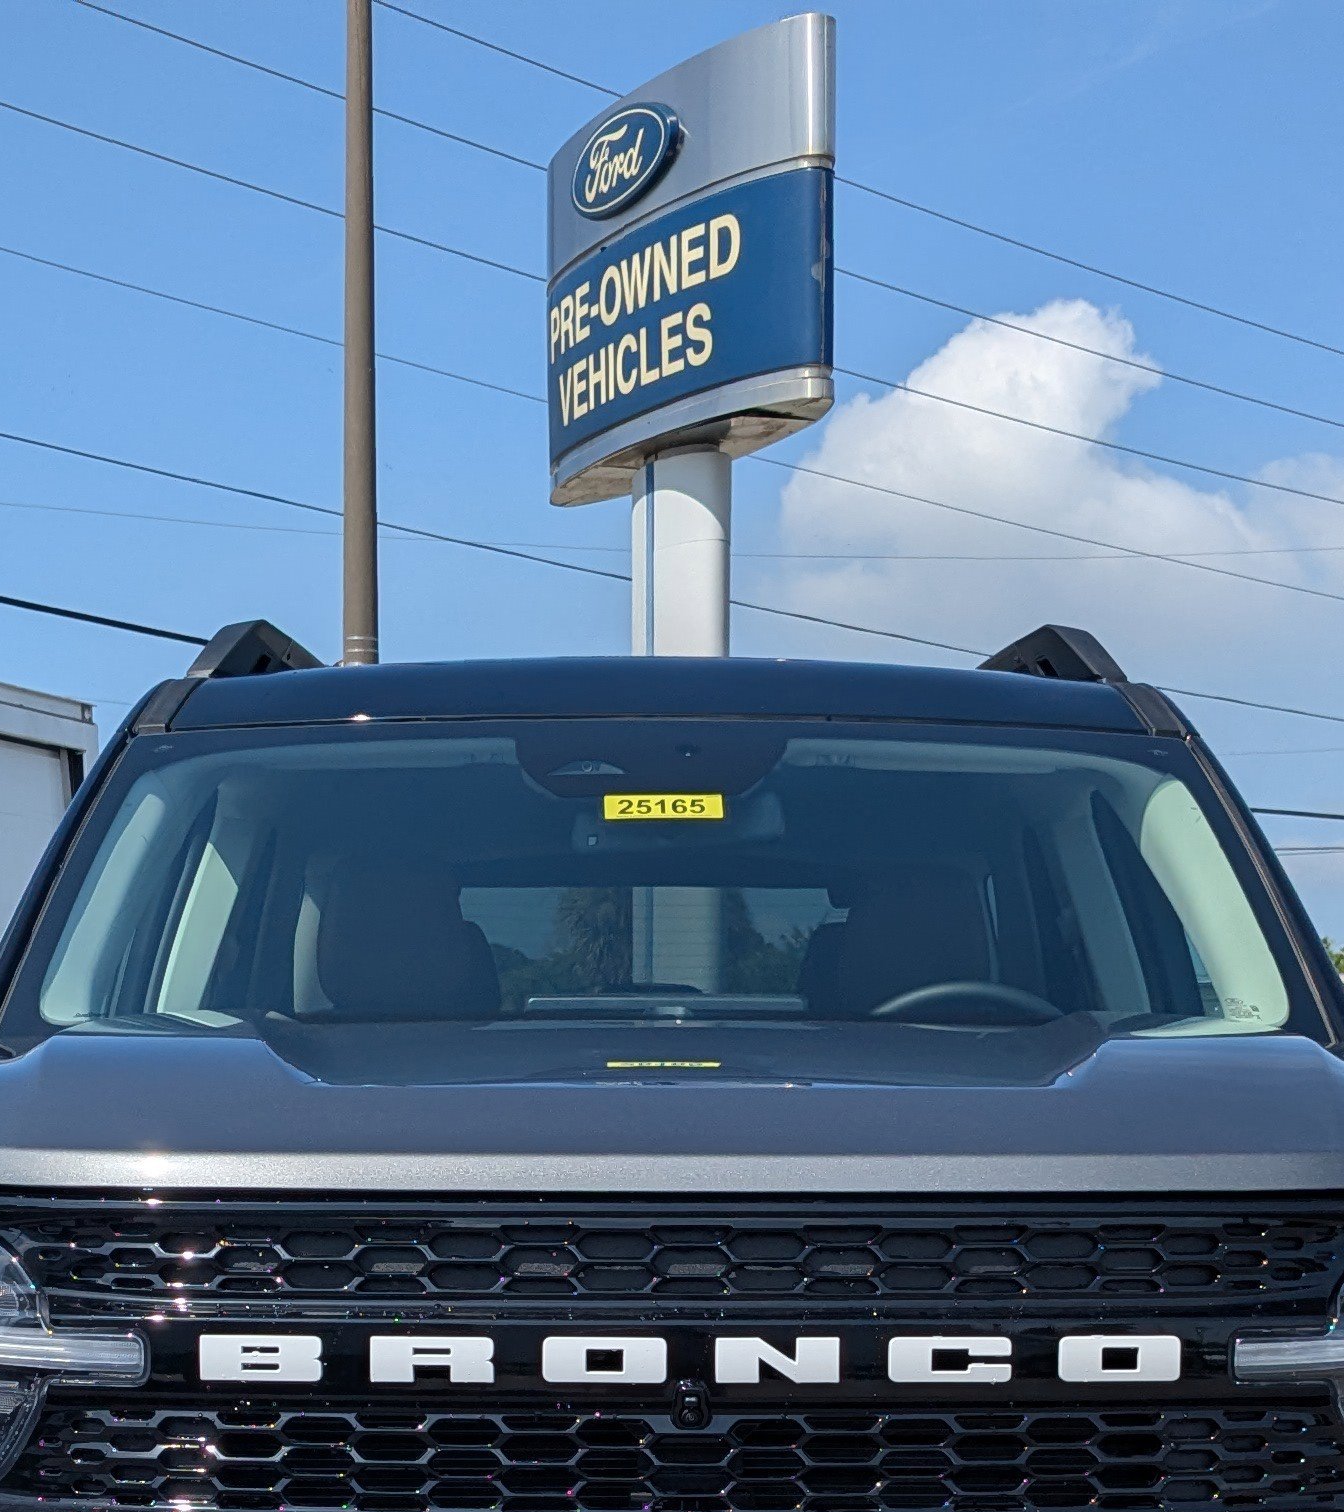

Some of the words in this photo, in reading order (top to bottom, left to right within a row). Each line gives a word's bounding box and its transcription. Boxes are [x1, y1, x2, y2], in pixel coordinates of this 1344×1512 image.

[584, 123, 645, 204] Ford
[550, 212, 741, 366] PRE-OWNED
[558, 301, 714, 428] VEHICLES
[617, 798, 706, 815] 25165
[199, 1334, 1182, 1384] BRONCO
